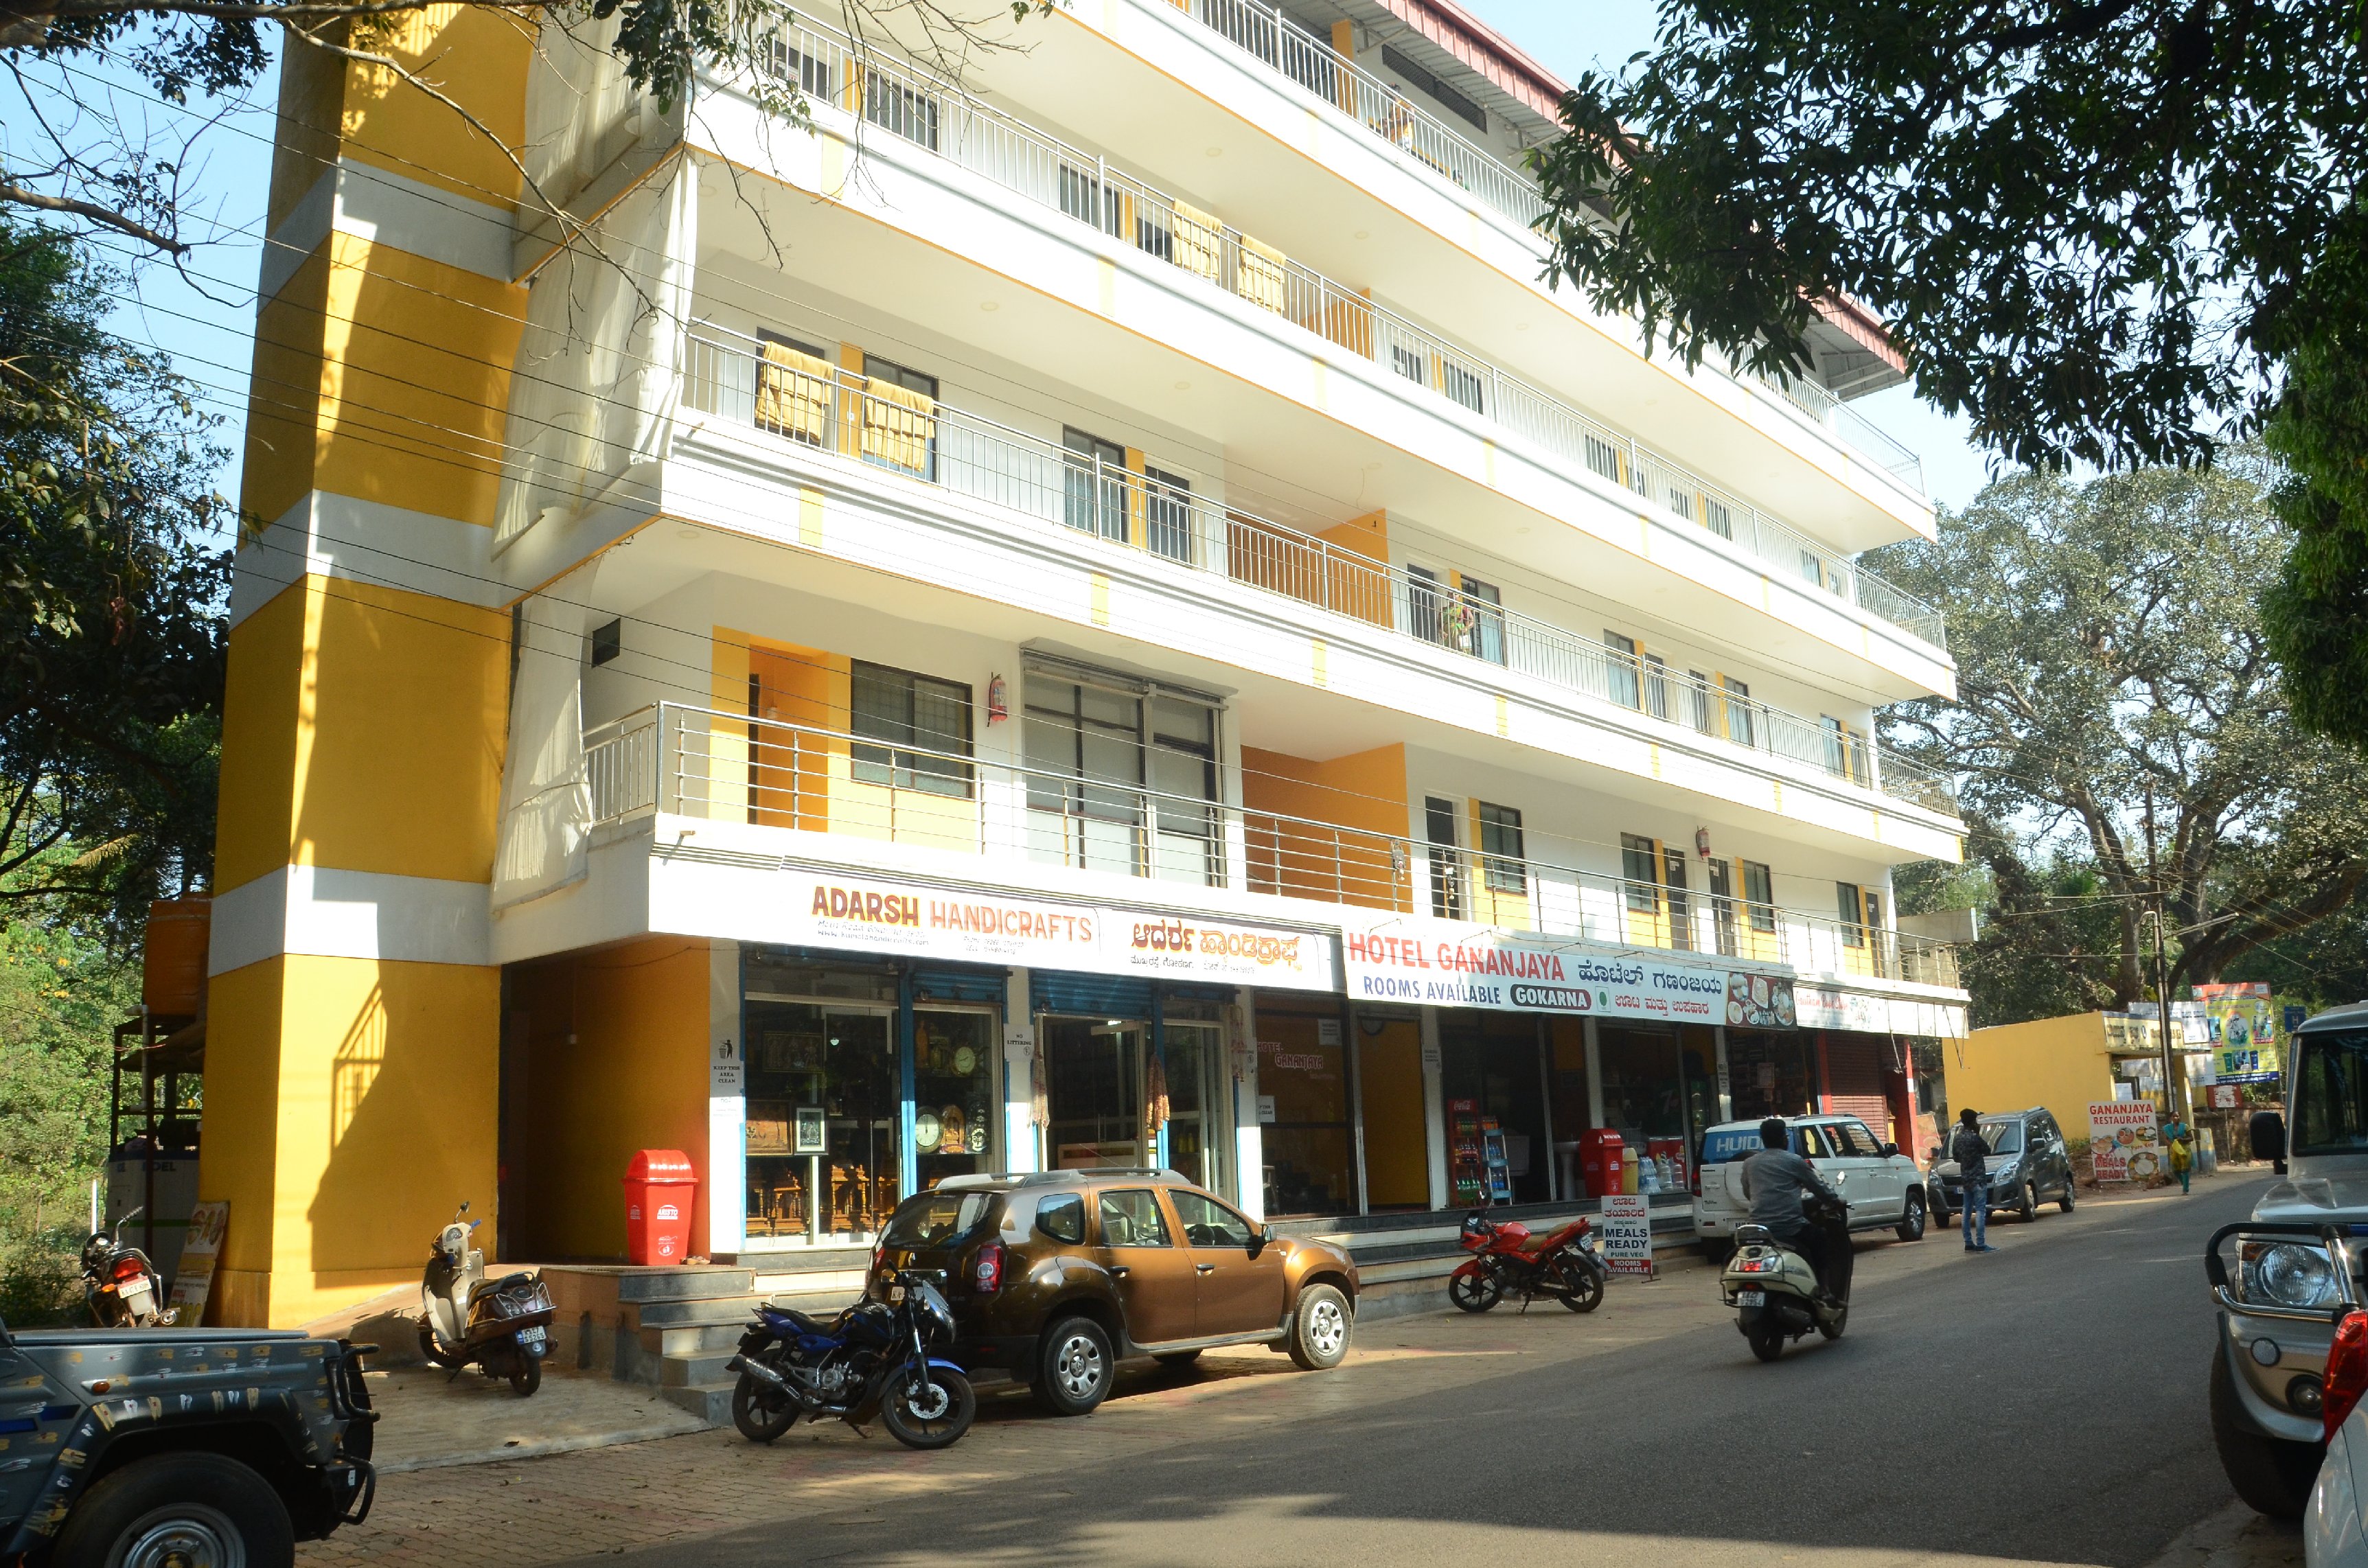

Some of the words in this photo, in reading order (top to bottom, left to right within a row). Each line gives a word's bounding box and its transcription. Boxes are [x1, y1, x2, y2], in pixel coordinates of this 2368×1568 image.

[812, 886, 919, 927] ADARSH
[930, 900, 1092, 942] HANDICRAFTS
[1348, 932, 1430, 969] HOTEL
[1437, 943, 1565, 982] GANANJAYA
[1364, 976, 1421, 999] ROOMS
[1427, 981, 1502, 1004] AVAILABLE
[1652, 969, 1722, 995] ಗಣಂಜಯ
[1515, 987, 1588, 1008] GOKARNA
[1615, 995, 1640, 1008] ಊಟ
[1644, 995, 1669, 1016] ಮತ್ತು
[1274, 1053, 1324, 1071] GANANJAYA
[2089, 1103, 2153, 1115] GANANJAYA
[2093, 1115, 2150, 1125] RESTAURANT
[2095, 1157, 2127, 1168] MEALS
[2096, 1169, 2127, 1179] READY
[1605, 1228, 1648, 1238] MEALS
[1606, 1240, 1648, 1249] READY
